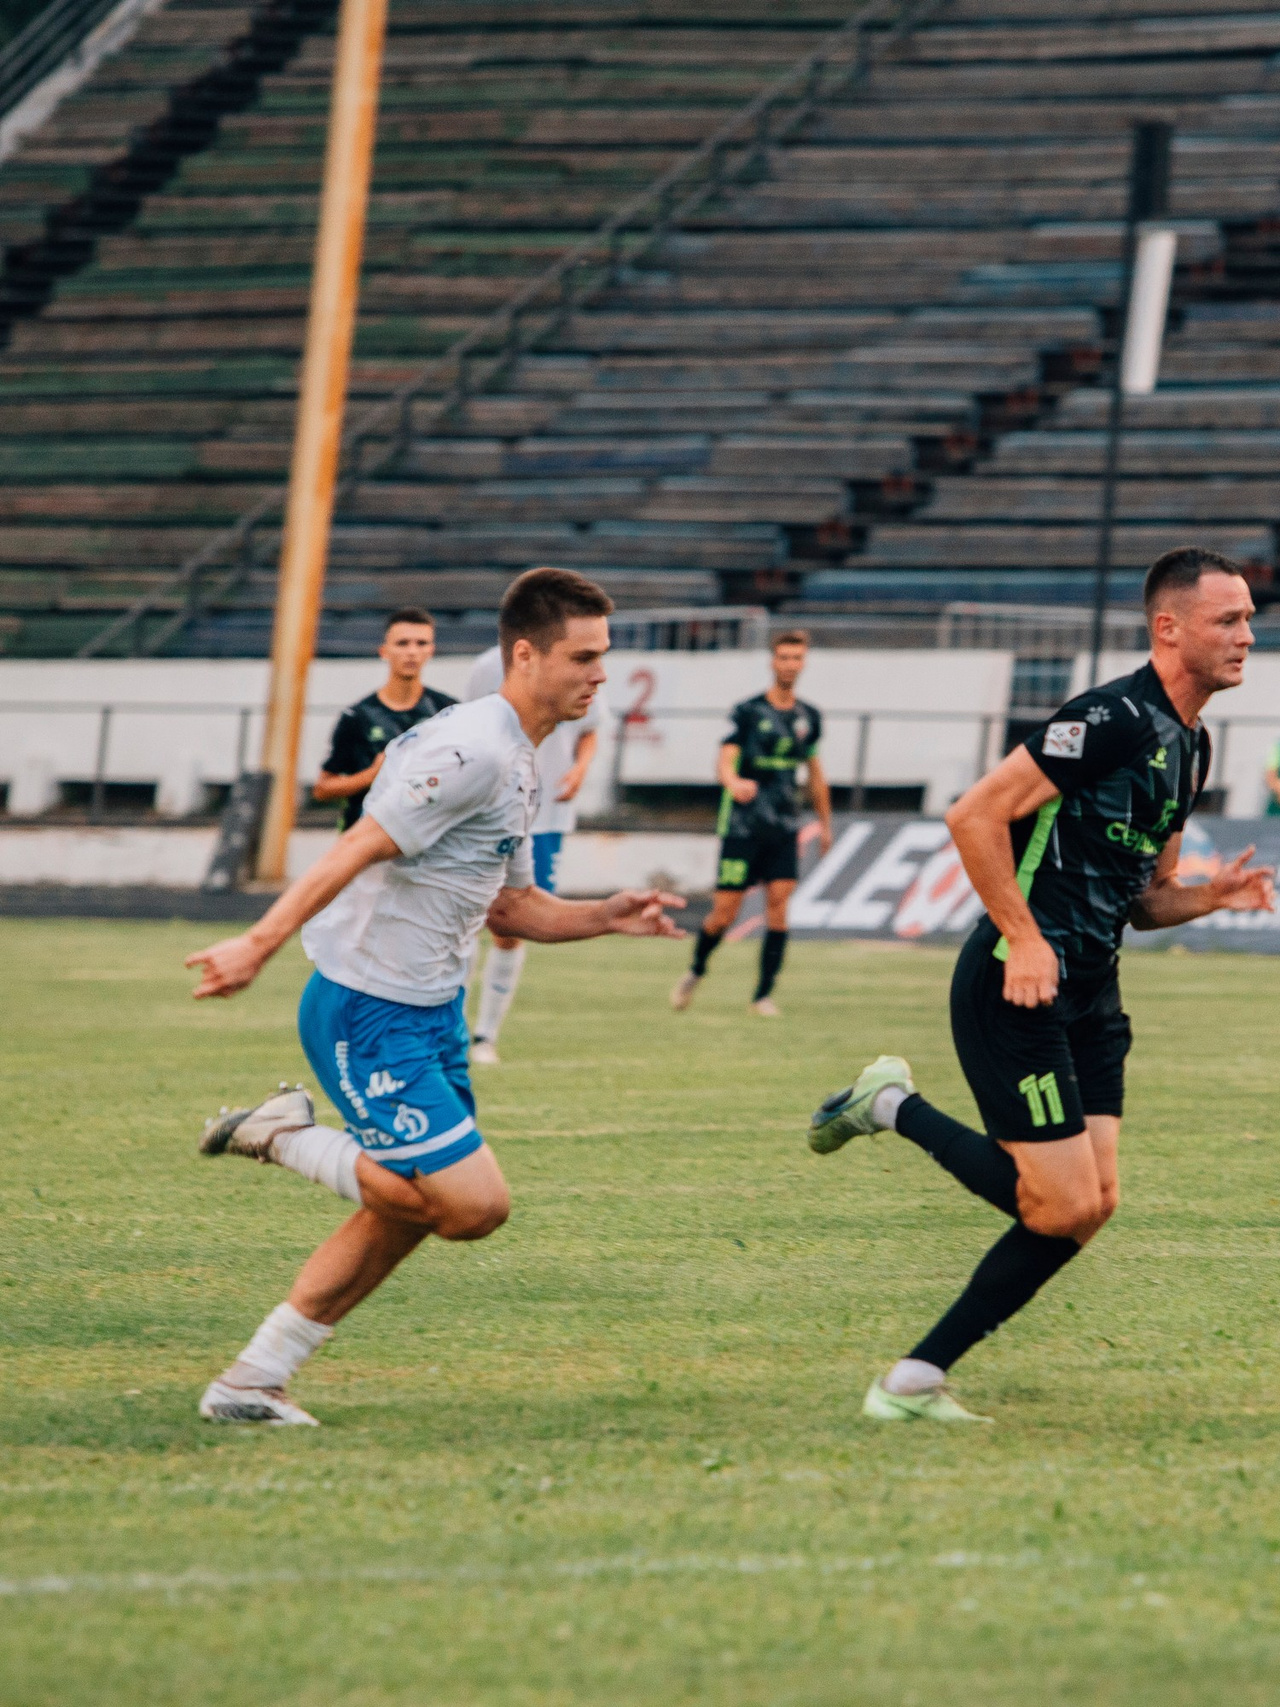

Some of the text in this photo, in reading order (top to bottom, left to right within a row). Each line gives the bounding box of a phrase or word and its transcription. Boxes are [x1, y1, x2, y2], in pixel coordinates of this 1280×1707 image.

[623, 668, 656, 725] 2
[786, 820, 988, 934] LEO
[1018, 1071, 1066, 1127] 11
